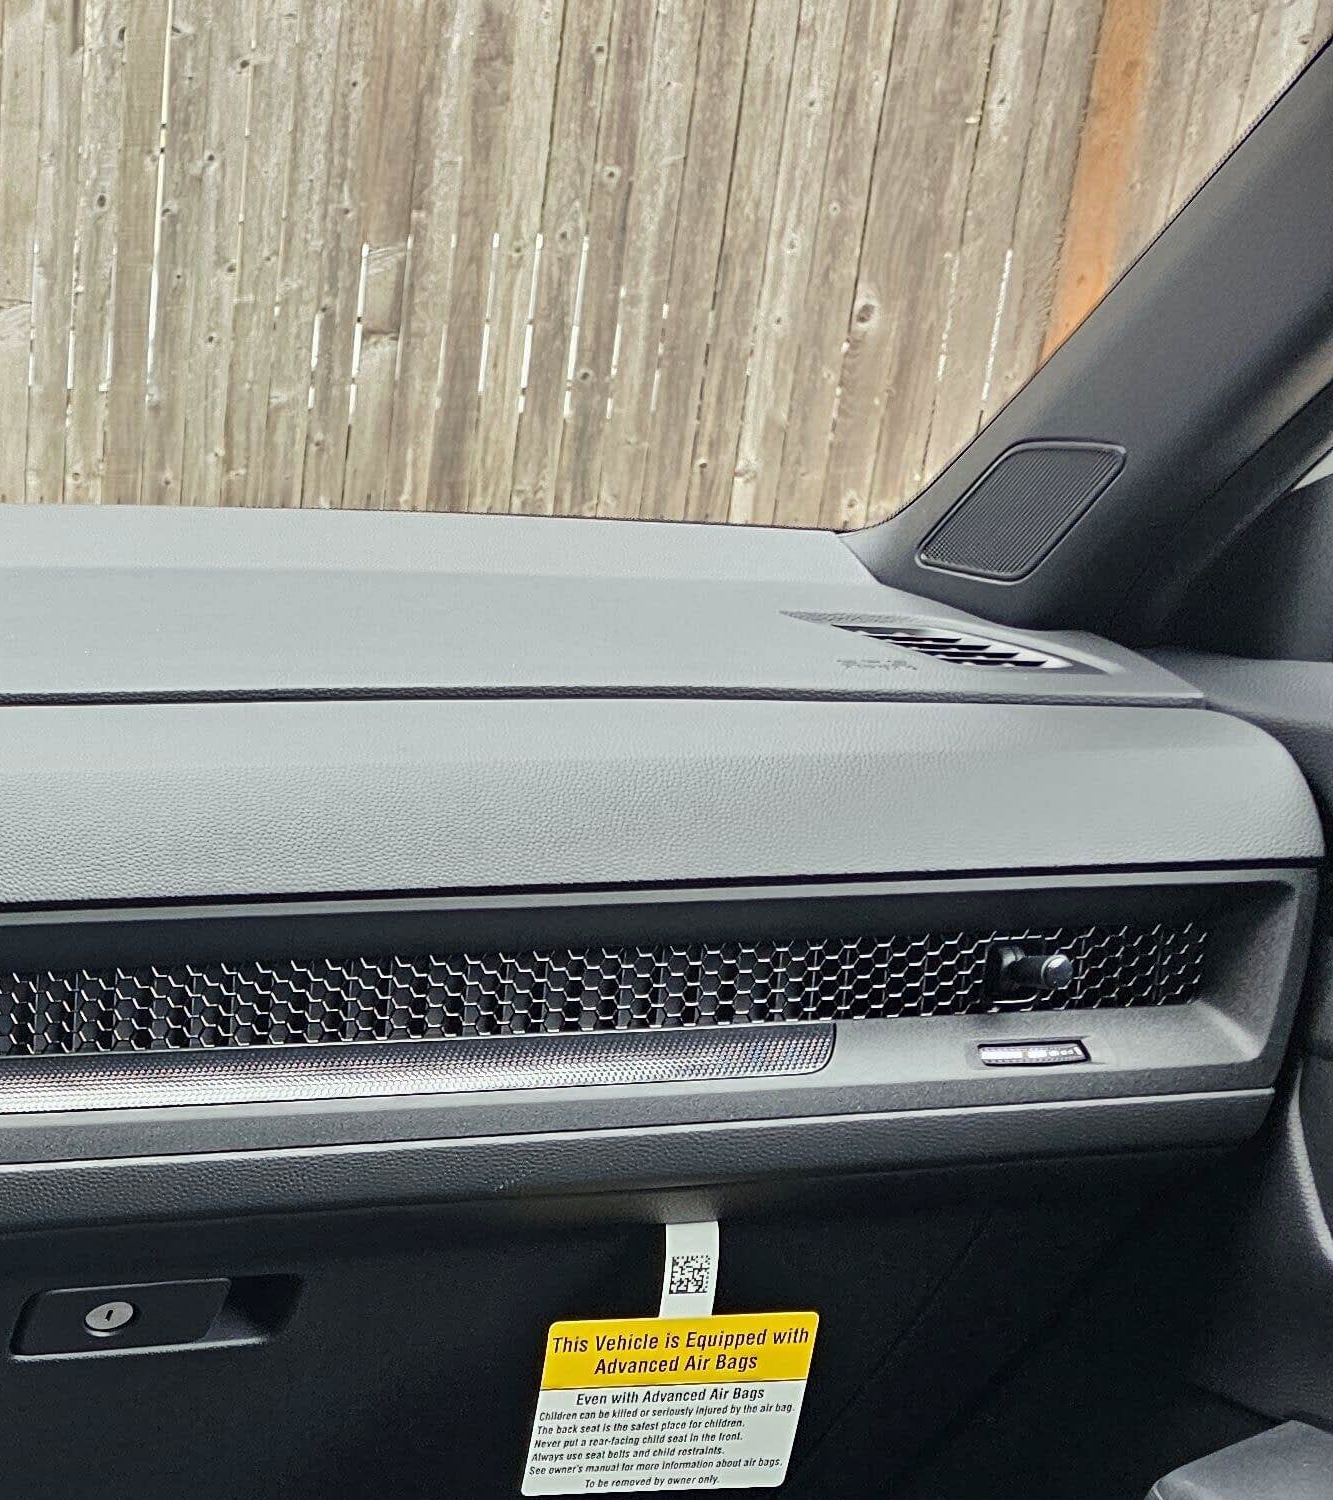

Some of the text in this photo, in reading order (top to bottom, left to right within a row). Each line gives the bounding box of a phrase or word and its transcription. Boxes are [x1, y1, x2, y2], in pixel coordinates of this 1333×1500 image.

[553, 1328, 808, 1353] This Vehicle is Equipped with
[594, 1354, 757, 1374] Advanced Air Bags
[576, 1387, 764, 1405] Even with Advanced Air Bags
[539, 1410, 577, 1421] Children
[579, 1412, 595, 1420] can
[599, 1410, 609, 1419] be
[612, 1408, 637, 1418] killed
[652, 1406, 692, 1417] seriously
[696, 1405, 727, 1416] injured
[730, 1405, 741, 1415] by
[744, 1404, 757, 1413] the
[760, 1404, 773, 1412] air
[775, 1403, 795, 1413] bag.
[538, 1418, 745, 1434] The back seat is the safest place for children.
[534, 1439, 561, 1448] Never
[563, 1439, 578, 1449] put
[589, 1436, 639, 1446] rear-facing
[642, 1434, 666, 1444] child
[667, 1433, 687, 1443] seat
[690, 1433, 698, 1442] in
[701, 1432, 715, 1441] the
[718, 1432, 743, 1441] front.
[532, 1453, 563, 1463] Always
[585, 1451, 605, 1460] seat
[607, 1450, 630, 1459] belts
[633, 1449, 650, 1458] and
[652, 1448, 675, 1457] child
[678, 1447, 724, 1456] restraints.
[529, 1457, 782, 1475] See owner's manual for more information about air bags.
[585, 1475, 720, 1488] To be removed by owner only.
